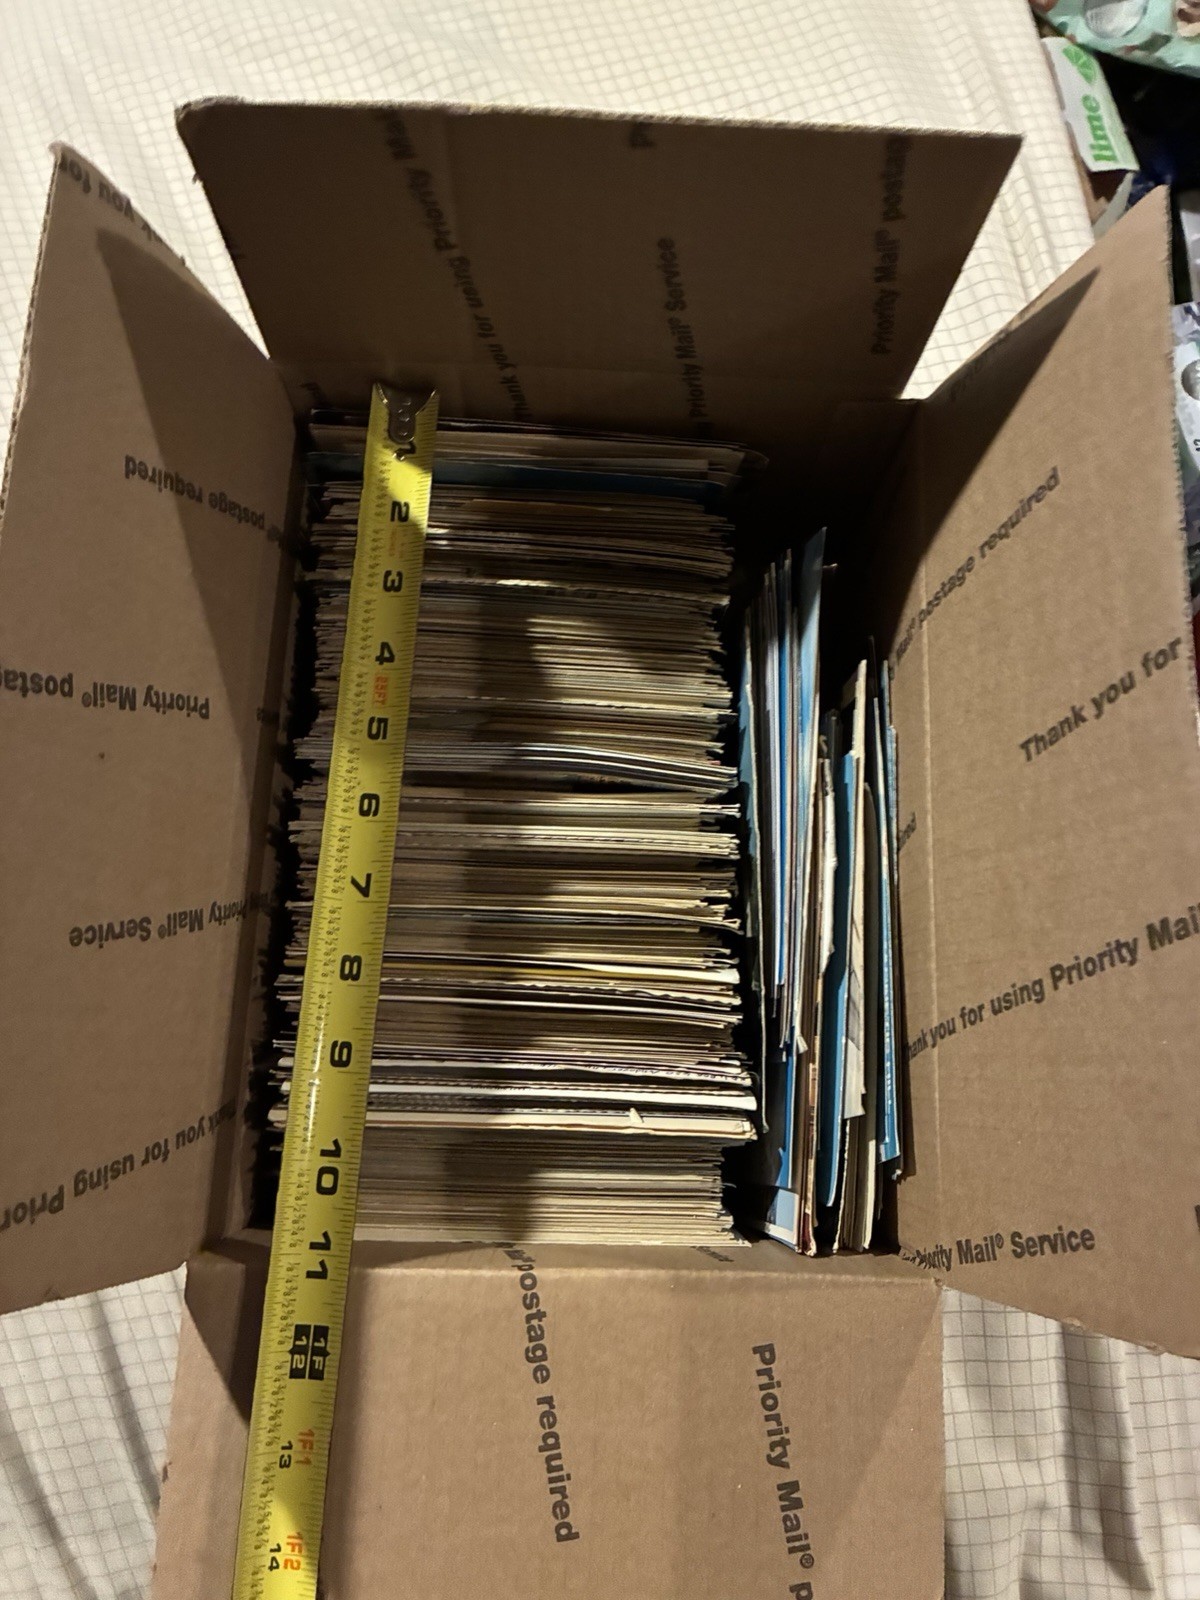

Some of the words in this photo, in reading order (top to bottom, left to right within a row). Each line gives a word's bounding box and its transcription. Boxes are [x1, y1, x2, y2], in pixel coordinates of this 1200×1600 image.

[1082, 94, 1119, 162] lime
[124, 454, 203, 505] required
[390, 501, 410, 523] 2
[979, 466, 1060, 558] required
[382, 569, 403, 593] 3
[375, 641, 395, 666] 4
[0, 668, 74, 698] posta
[1019, 704, 1089, 762] Thank
[1091, 671, 1138, 719] you
[1141, 637, 1182, 677] for
[143, 684, 210, 719] Priority
[367, 716, 388, 741] 5
[358, 792, 380, 818] 6
[350, 872, 372, 898] 7
[69, 916, 152, 949] Service
[339, 954, 362, 982] 8
[929, 1017, 956, 1049] you
[959, 1003, 985, 1029] for
[990, 977, 1046, 1016] using
[1050, 936, 1139, 991] Priority
[1146, 902, 1200, 952] Mai
[330, 1040, 353, 1068] 9
[175, 1115, 205, 1150] you
[142, 1137, 170, 1166] for
[316, 1138, 342, 1196] 10
[73, 1154, 135, 1198] using
[305, 1230, 332, 1281] 11
[1011, 1225, 1096, 1259] Service
[292, 1335, 307, 1369] 12
[511, 1261, 551, 1385] postage
[536, 1395, 580, 1543] required
[752, 1343, 791, 1470] Priority
[279, 1440, 294, 1470] 13
[268, 1543, 282, 1572] 14
